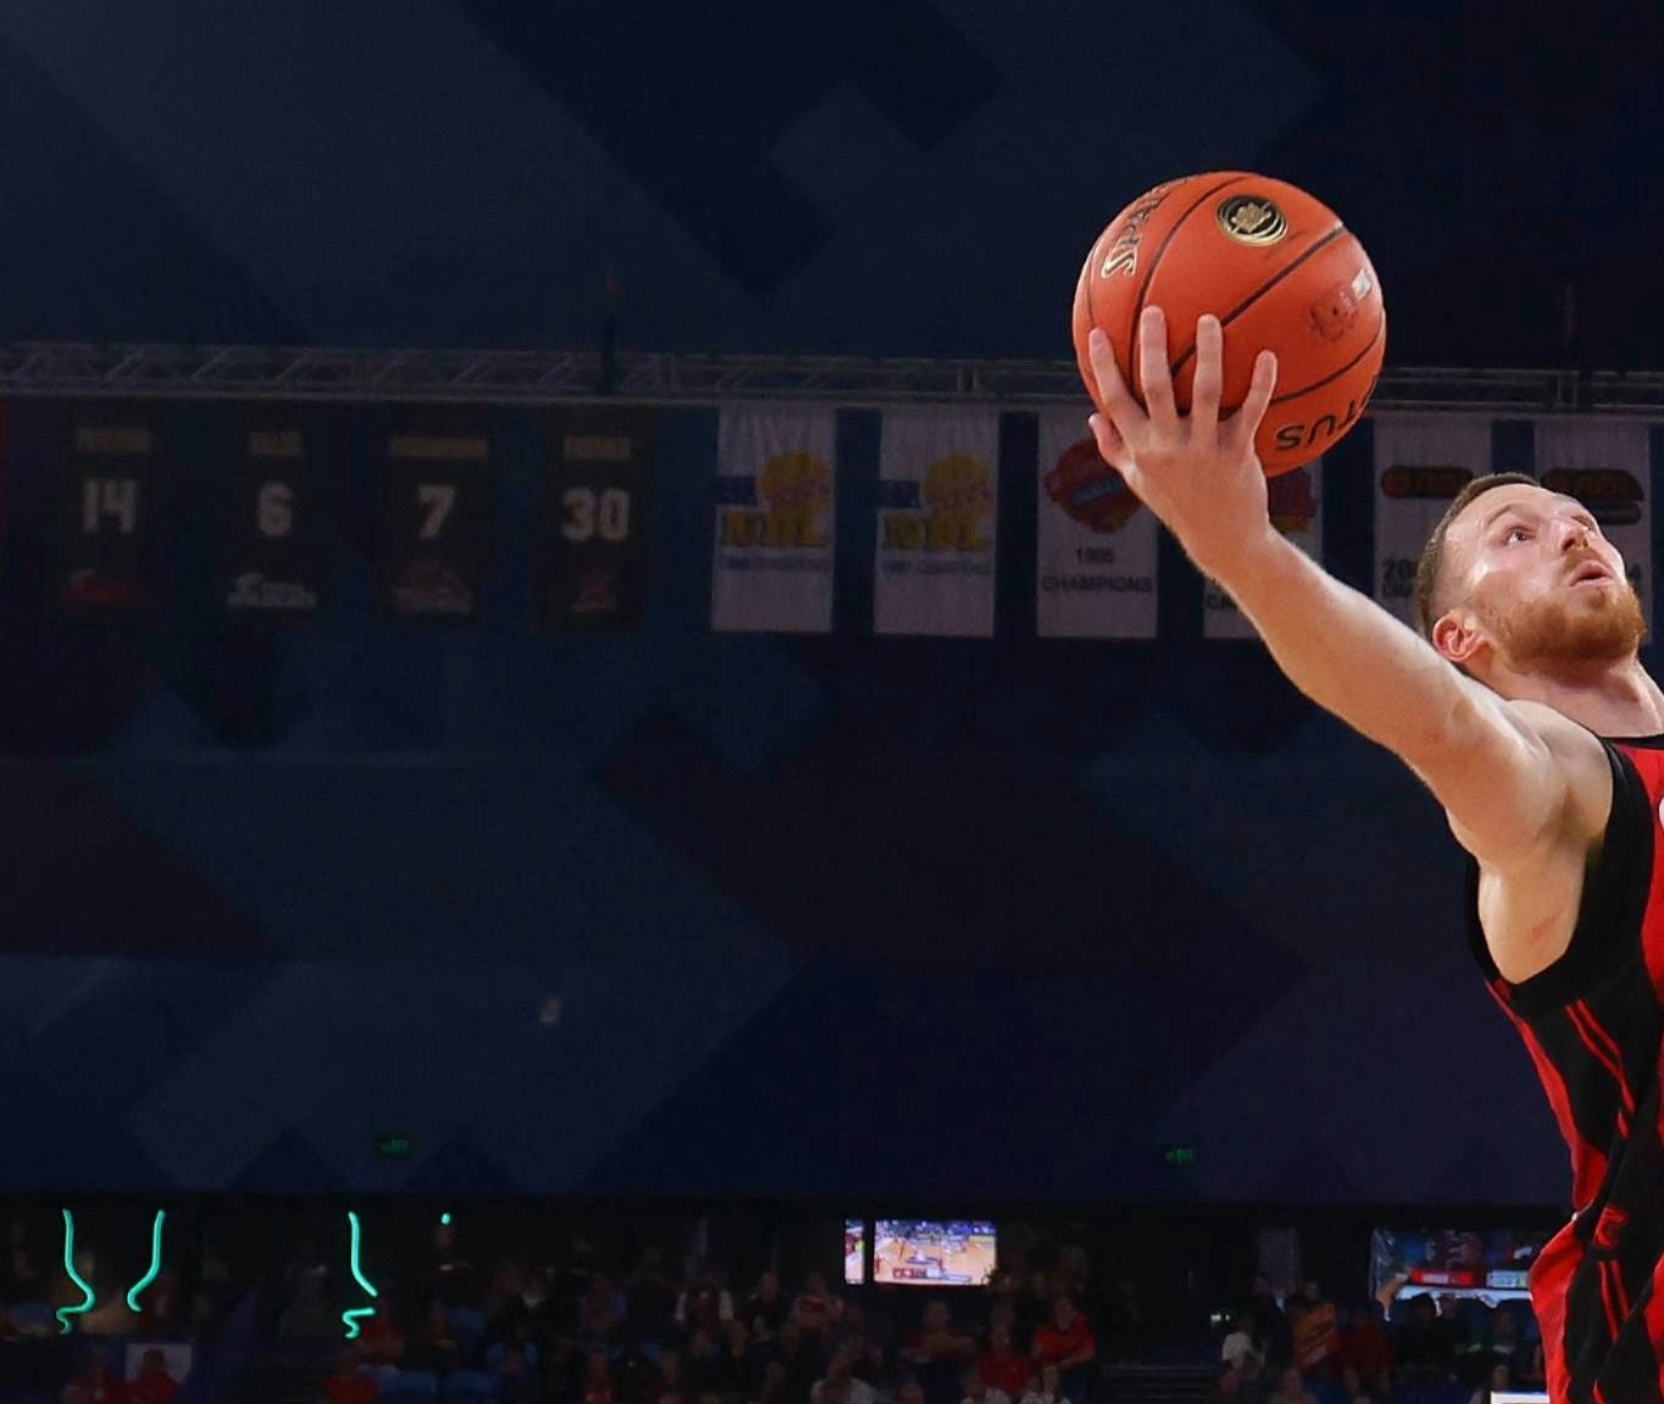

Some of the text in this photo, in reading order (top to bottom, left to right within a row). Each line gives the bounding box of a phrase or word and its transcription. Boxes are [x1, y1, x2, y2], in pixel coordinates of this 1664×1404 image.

[82, 477, 136, 533] 14
[257, 482, 292, 537] 6
[418, 484, 456, 540] 7
[561, 488, 630, 543] 30
[1043, 576, 1152, 592] CHAMPIONS
